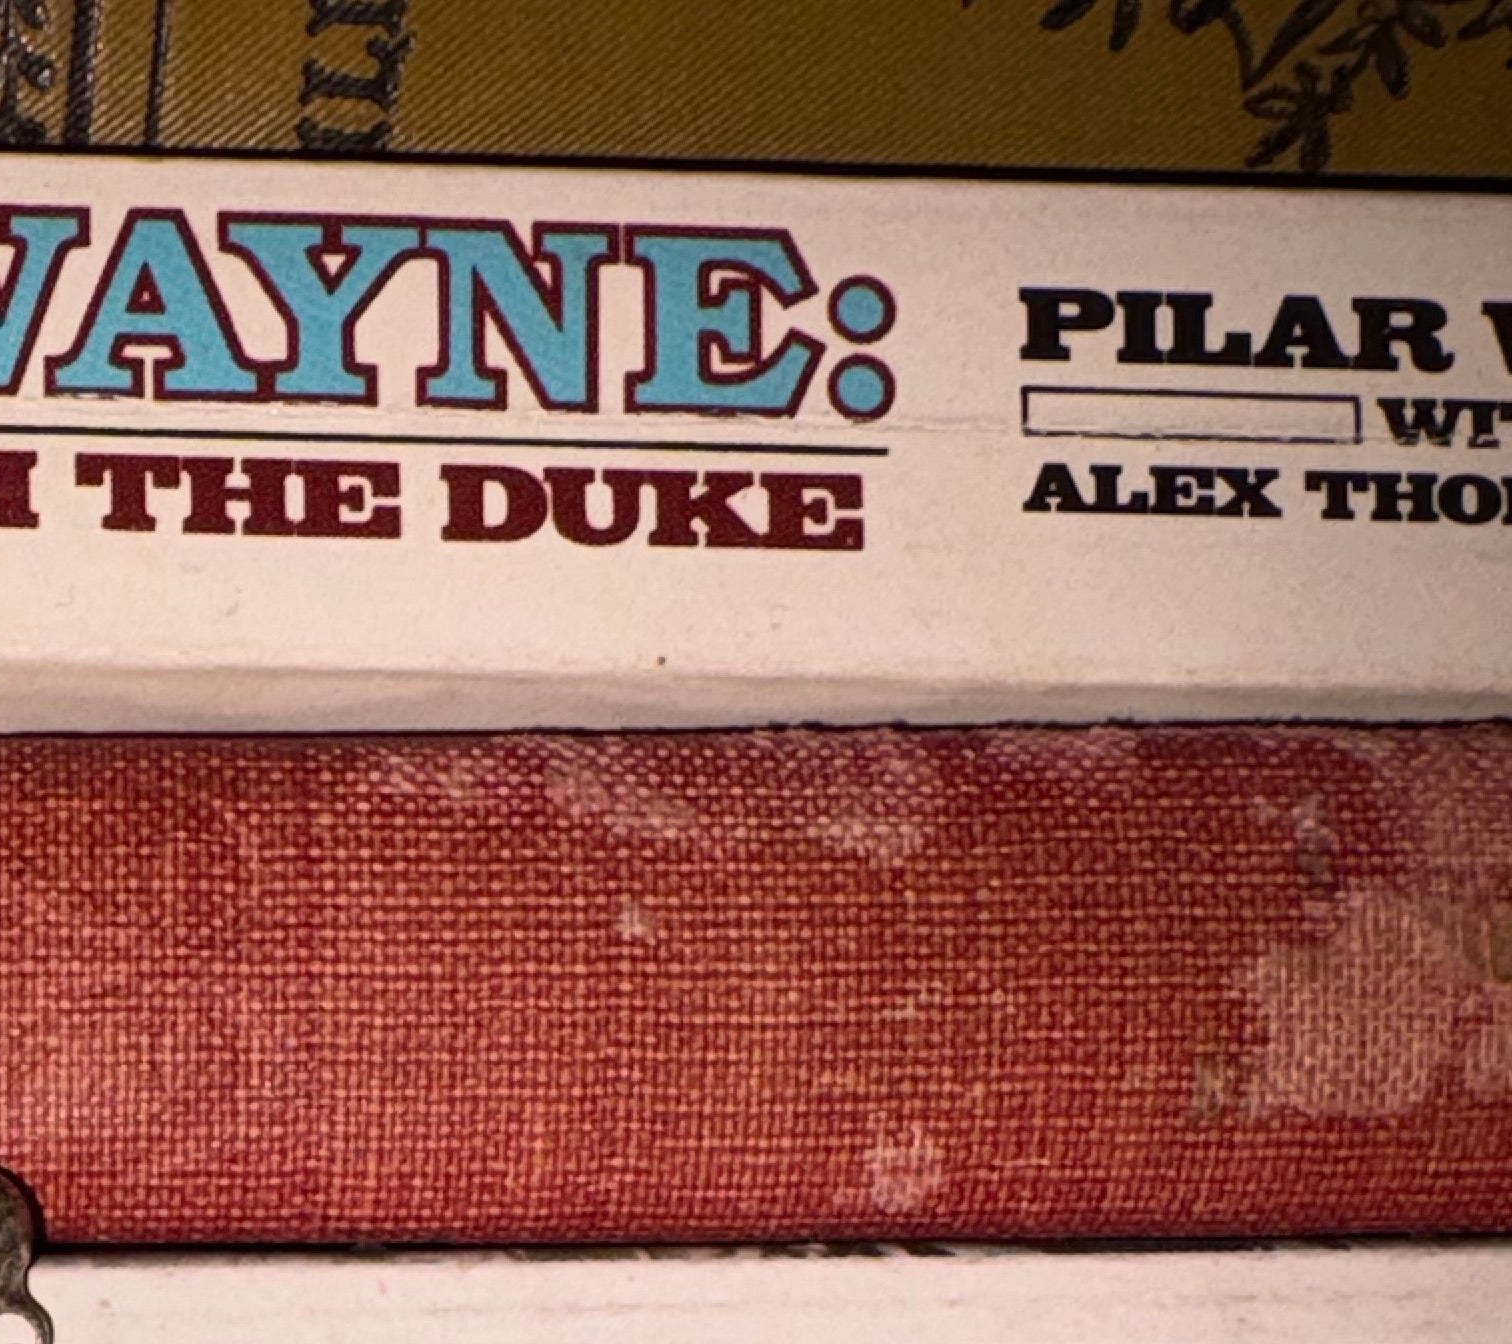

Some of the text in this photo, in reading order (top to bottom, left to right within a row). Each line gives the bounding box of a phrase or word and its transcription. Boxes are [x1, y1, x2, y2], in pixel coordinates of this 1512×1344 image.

[1018, 286, 1455, 374] PILAR
[1376, 396, 1512, 449] WI
[75, 451, 402, 540] THE
[440, 462, 865, 552] DUKE
[1022, 462, 1512, 526] ALEX THO
